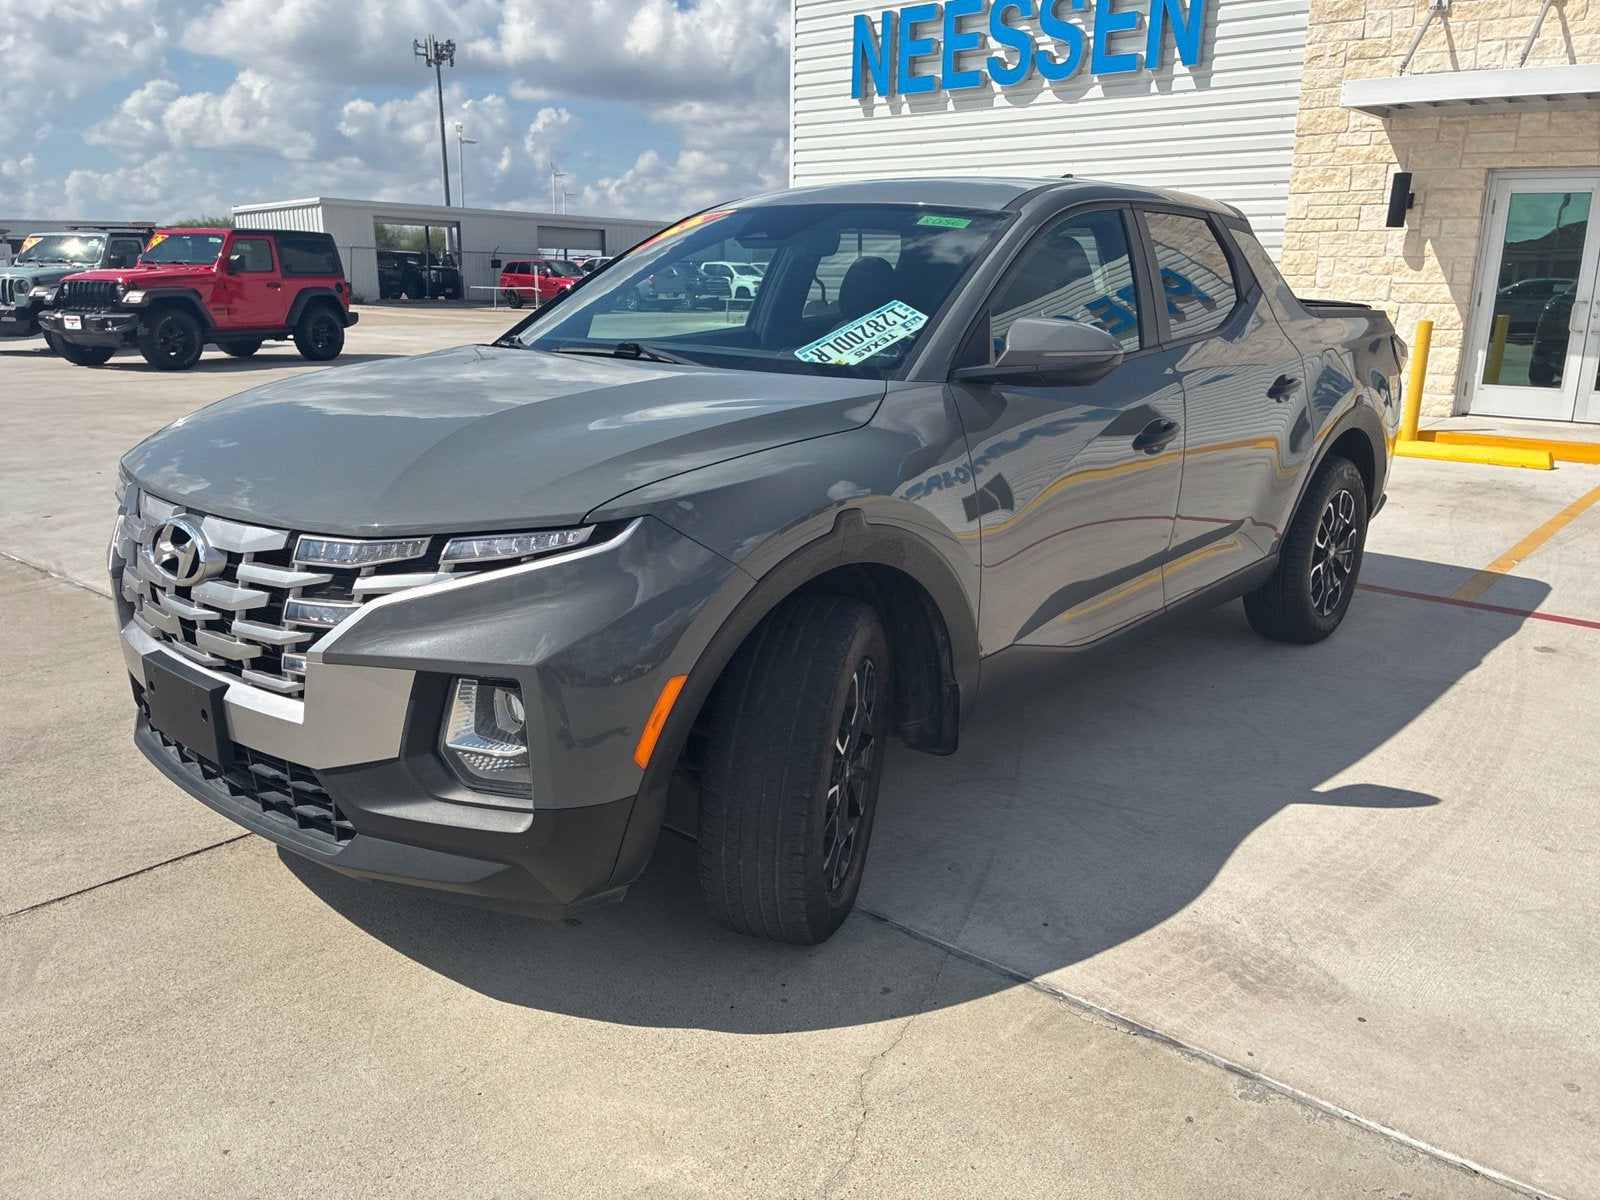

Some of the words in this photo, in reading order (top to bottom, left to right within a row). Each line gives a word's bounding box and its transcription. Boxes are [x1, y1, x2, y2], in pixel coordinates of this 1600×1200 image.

[851, 0, 1205, 99] NEESSEN
[809, 307, 909, 363] 12820DLR
[854, 333, 898, 358] TEXAS
